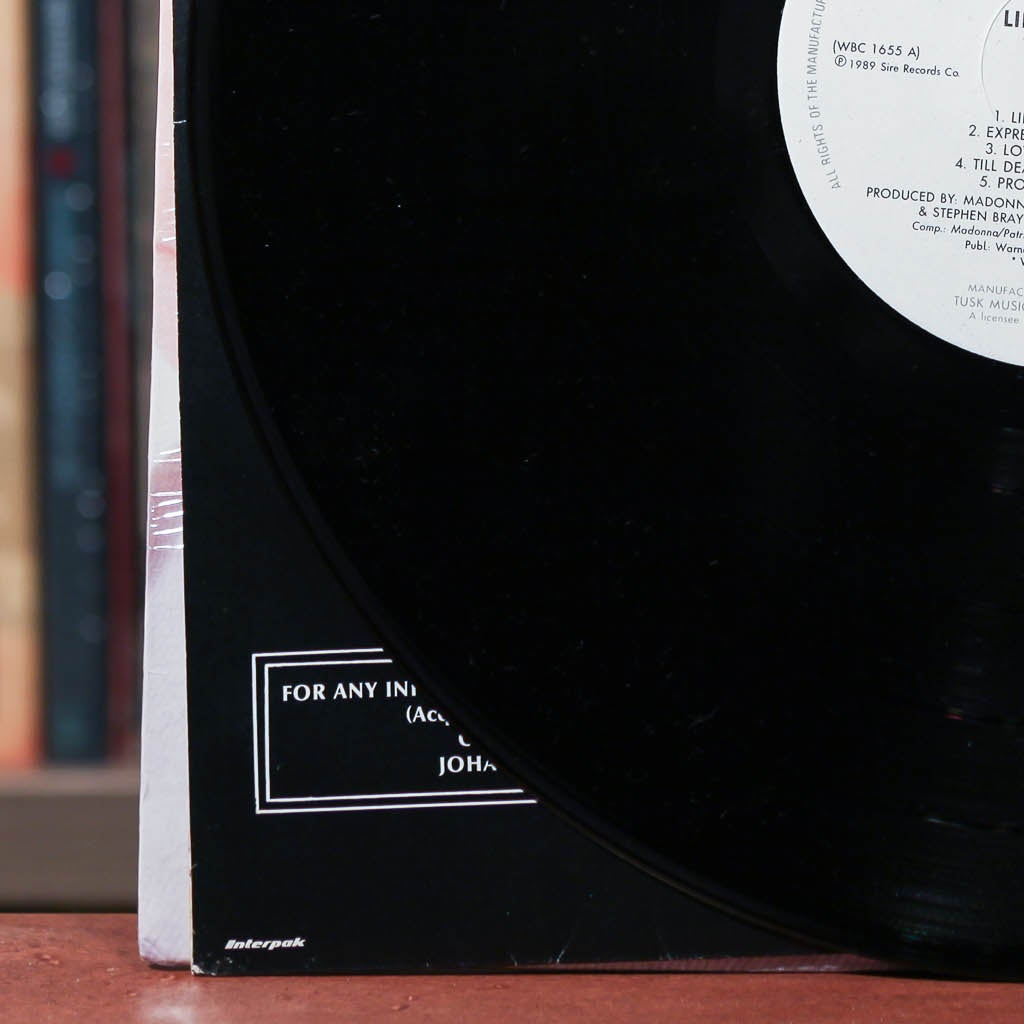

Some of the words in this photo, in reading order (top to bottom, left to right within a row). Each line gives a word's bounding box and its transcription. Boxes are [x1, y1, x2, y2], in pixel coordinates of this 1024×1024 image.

[832, 39, 866, 54] (WBC
[872, 44, 902, 56] 1655
[908, 46, 920, 60] A)
[850, 59, 876, 70] 1989
[880, 62, 899, 72] Sire
[903, 64, 941, 76] Records
[806, 79, 818, 100] THE
[808, 105, 821, 118] OF
[995, 110, 1004, 122] 1.
[968, 124, 980, 137] 2.
[812, 124, 831, 166] RIGHTS
[985, 143, 996, 155] 3.
[955, 158, 966, 170] 4.
[973, 158, 997, 172] TILL
[825, 169, 841, 190] ALL
[979, 176, 990, 188] 5.
[866, 186, 935, 202] PRODUCED
[940, 194, 958, 204] BY:
[918, 206, 928, 217] &
[932, 207, 988, 222] STEPHEN
[992, 212, 1024, 225] BRAY
[954, 296, 984, 308] TUSK
[969, 312, 976, 320] A
[981, 312, 1020, 325] licensee
[282, 683, 326, 702] FOR
[333, 681, 378, 700] ANY
[224, 937, 306, 950] Interpak
